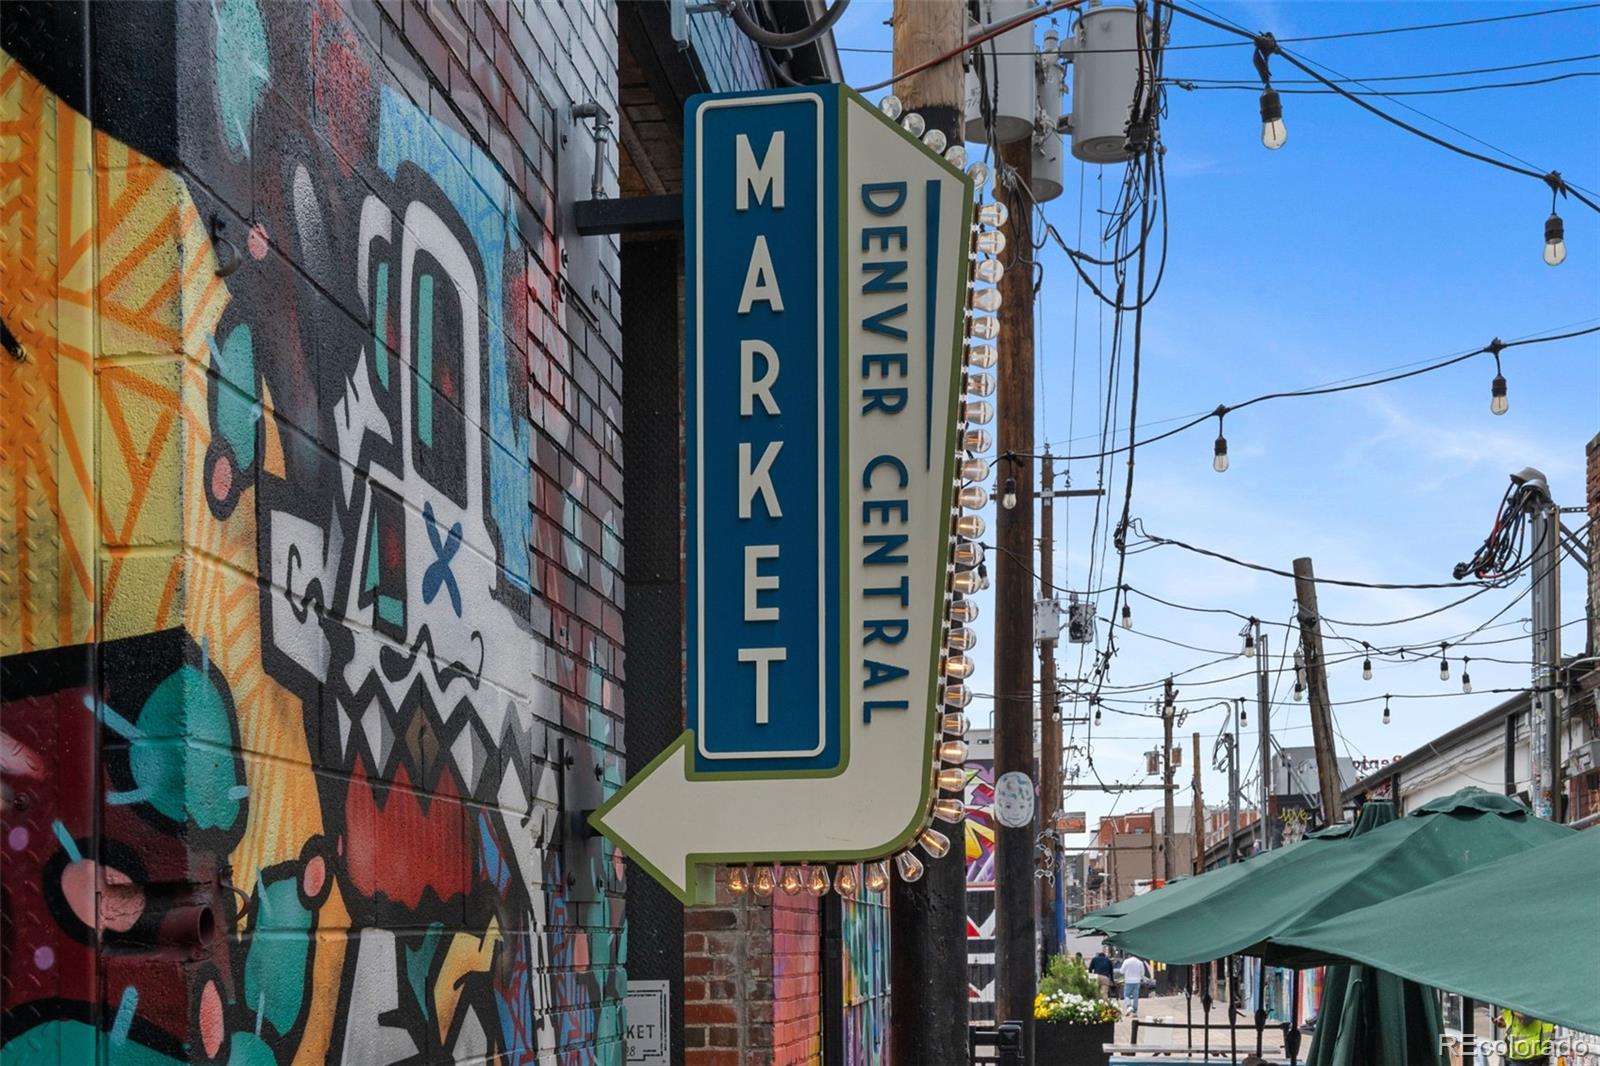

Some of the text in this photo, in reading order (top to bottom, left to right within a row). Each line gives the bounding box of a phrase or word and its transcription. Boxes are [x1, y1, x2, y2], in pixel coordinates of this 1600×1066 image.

[735, 131, 787, 725] MARKET
[861, 181, 910, 724] DENVER CENTRAL
